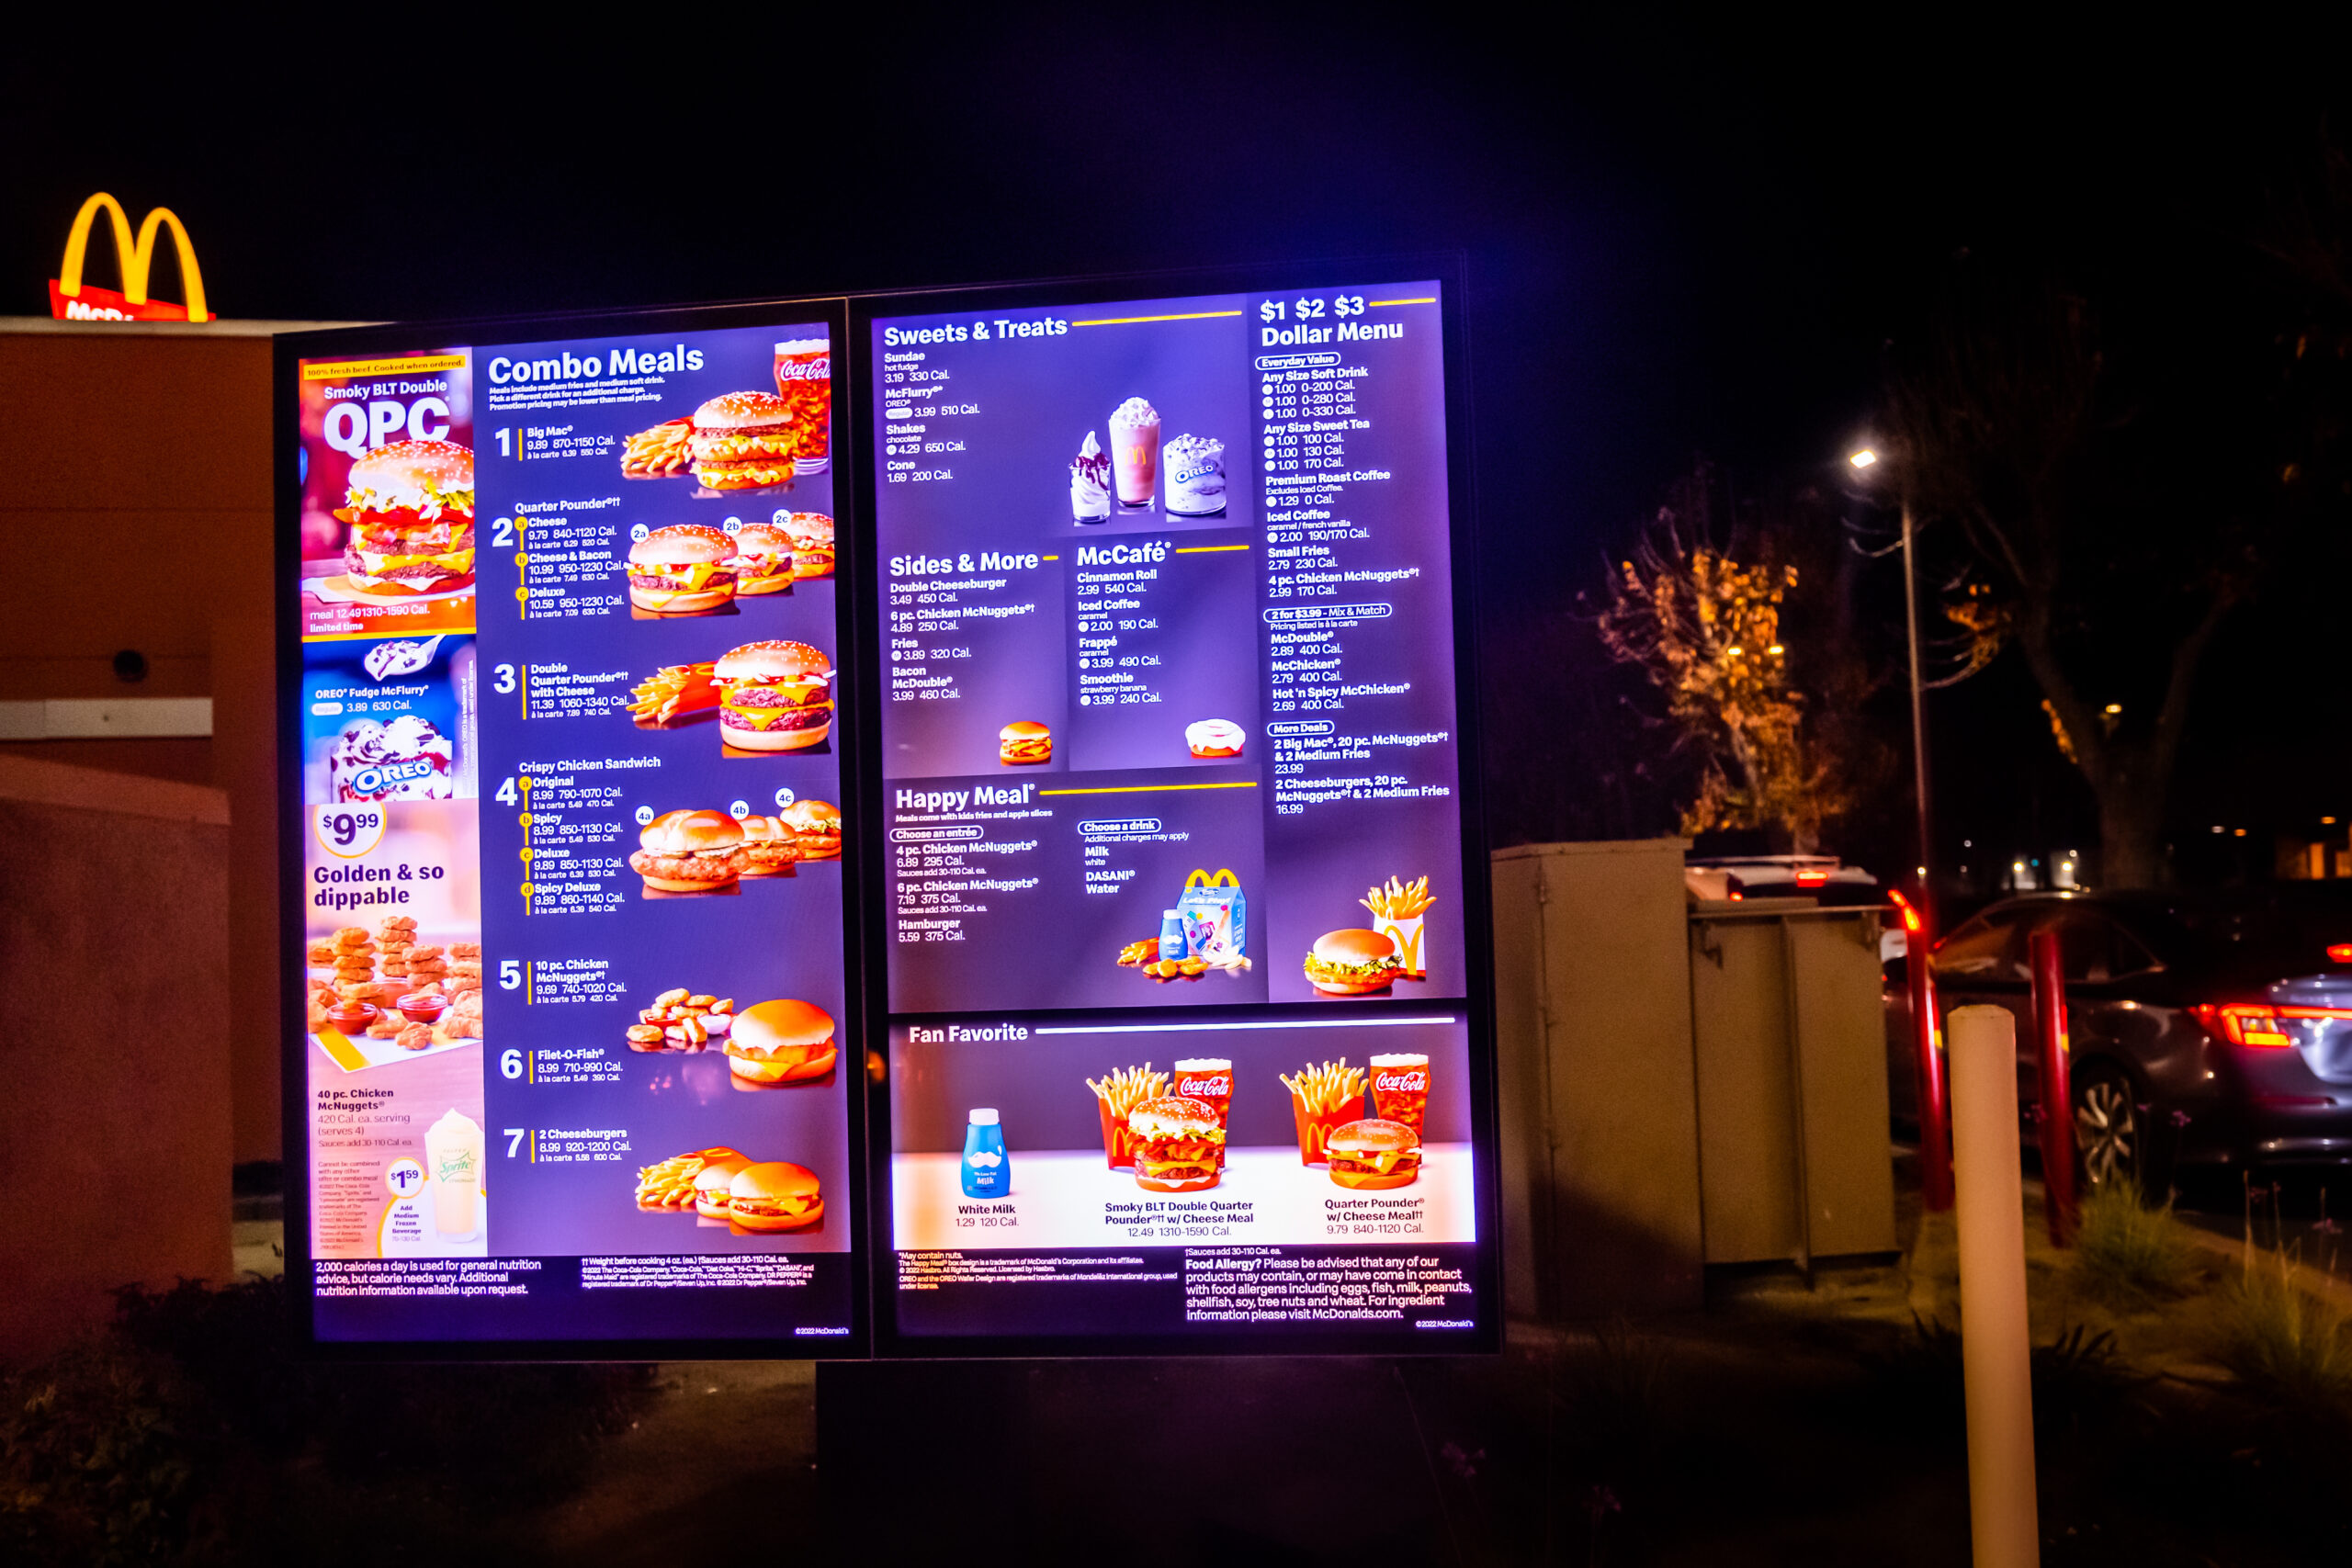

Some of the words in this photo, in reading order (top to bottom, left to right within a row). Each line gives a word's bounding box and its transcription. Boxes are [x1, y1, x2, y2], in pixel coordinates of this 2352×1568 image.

[1260, 299, 1284, 323] $1
[1295, 297, 1325, 321] $2
[1334, 294, 1364, 318] $3
[884, 323, 967, 345] Sweets
[972, 321, 989, 340] &
[993, 317, 1067, 338] Treats
[1261, 323, 1332, 346] Dollar
[1337, 321, 1403, 341] Menu
[884, 351, 925, 362] Sundae
[1262, 357, 1306, 367] Everyday
[1307, 355, 1335, 365] Value
[489, 352, 602, 384] Combo
[609, 344, 704, 376] Meals
[885, 372, 903, 383] 3.19
[909, 370, 928, 381] 330
[930, 369, 949, 379] Cal.
[324, 384, 370, 400] Smoky
[373, 382, 397, 395] BLT
[400, 378, 447, 393] Double
[323, 397, 450, 459] QPC
[527, 426, 544, 439] Big
[494, 427, 510, 457] 1
[526, 437, 548, 450] 9.89
[552, 436, 594, 448] 870-1150
[596, 434, 615, 448] Cal.
[887, 460, 915, 470] Cone
[1265, 474, 1317, 486] Premium
[1317, 472, 1351, 483] Roast
[1352, 469, 1390, 481] Coffee
[514, 501, 558, 514] Quarter
[528, 517, 568, 528] Cheese
[775, 514, 788, 524] 2c
[492, 517, 514, 547] 2
[528, 529, 548, 540] 9.79
[553, 526, 595, 539] 840-1120
[598, 525, 616, 539] Cal.
[726, 522, 740, 531] 2b
[634, 529, 646, 538] 2a
[889, 554, 952, 576] Sides
[957, 553, 975, 572] &
[979, 551, 1038, 570] More
[1077, 571, 1134, 582] Cinnamon
[1136, 569, 1157, 580] Roll
[310, 623, 341, 632] limited
[343, 621, 363, 630] time
[891, 637, 918, 650] Fries
[530, 662, 567, 673] Double
[493, 664, 515, 694] 3
[349, 687, 379, 698] Fudge
[346, 702, 368, 712] 3.89
[372, 701, 390, 711] 630
[392, 699, 412, 710] Cal.
[519, 761, 555, 774] Crispy
[557, 759, 603, 771] Chicken
[605, 756, 661, 769] Sandwich
[1274, 762, 1303, 773] 23.99
[355, 762, 431, 791] OREO
[495, 777, 517, 807] 4
[779, 793, 791, 802] 4c
[896, 789, 969, 812] Happy
[733, 806, 746, 815] 4b
[1275, 804, 1303, 814] 16.99
[639, 812, 650, 820] 4a
[1084, 822, 1121, 832] Choose
[1129, 821, 1156, 830] drink
[1084, 845, 1109, 856] Milk
[313, 864, 390, 883] Golden
[397, 863, 413, 880] &
[419, 865, 444, 879] so
[314, 886, 410, 910] dippable
[899, 919, 960, 932] Hamburger
[499, 960, 521, 989] 5
[910, 1026, 944, 1043] Fan
[948, 1023, 1027, 1042] Favorite
[501, 1049, 523, 1078] 6
[317, 1090, 330, 1099] 40
[333, 1091, 347, 1100] pc.
[350, 1088, 393, 1098] Chicken
[317, 1114, 335, 1123] 420
[337, 1114, 356, 1122] Cal.
[374, 1114, 410, 1124] serving
[318, 1127, 353, 1135] (serves
[355, 1126, 364, 1134] 4)
[539, 1129, 546, 1139] 2
[548, 1129, 628, 1141] Cheeseburgers
[503, 1128, 525, 1157] 7
[539, 1142, 560, 1152] 8.99
[565, 1141, 610, 1152] 920-1200
[612, 1140, 631, 1151] Cal.
[440, 1158, 472, 1175] Sprite
[957, 1204, 989, 1213] White
[992, 1203, 1015, 1213] Milk
[1105, 1202, 1142, 1213] Smoky
[1145, 1201, 1165, 1211] BLT
[1168, 1201, 1206, 1211] Double
[1209, 1201, 1252, 1212] Quarter
[956, 1217, 975, 1226] 1.29
[979, 1217, 997, 1226] 120
[1000, 1216, 1018, 1226] Cal.
[316, 1262, 342, 1274] 2,000
[344, 1261, 382, 1272] calories
[382, 1263, 389, 1271] a
[390, 1261, 408, 1274] day
[410, 1260, 418, 1270] is
[420, 1260, 443, 1270] used
[445, 1259, 459, 1270] for
[460, 1259, 497, 1272] general
[499, 1259, 541, 1269] nutrition
[1185, 1258, 1213, 1272] Food
[1215, 1258, 1261, 1271] Allergy?
[1263, 1258, 1299, 1271] Please
[1301, 1257, 1315, 1268] be
[1317, 1257, 1359, 1270] advised
[1361, 1256, 1384, 1267] that
[1385, 1258, 1405, 1269] any
[1407, 1257, 1419, 1268] of
[1419, 1258, 1439, 1266] our
[316, 1273, 350, 1284] advice,
[351, 1273, 368, 1283] but
[369, 1272, 402, 1283] calorie
[403, 1272, 434, 1282] needs
[435, 1274, 457, 1284] vary.
[458, 1271, 508, 1282] Additional
[316, 1285, 357, 1295] nutrition
[359, 1284, 415, 1295] information
[416, 1283, 459, 1294] available
[460, 1285, 486, 1296] upon
[488, 1283, 527, 1296] request.
